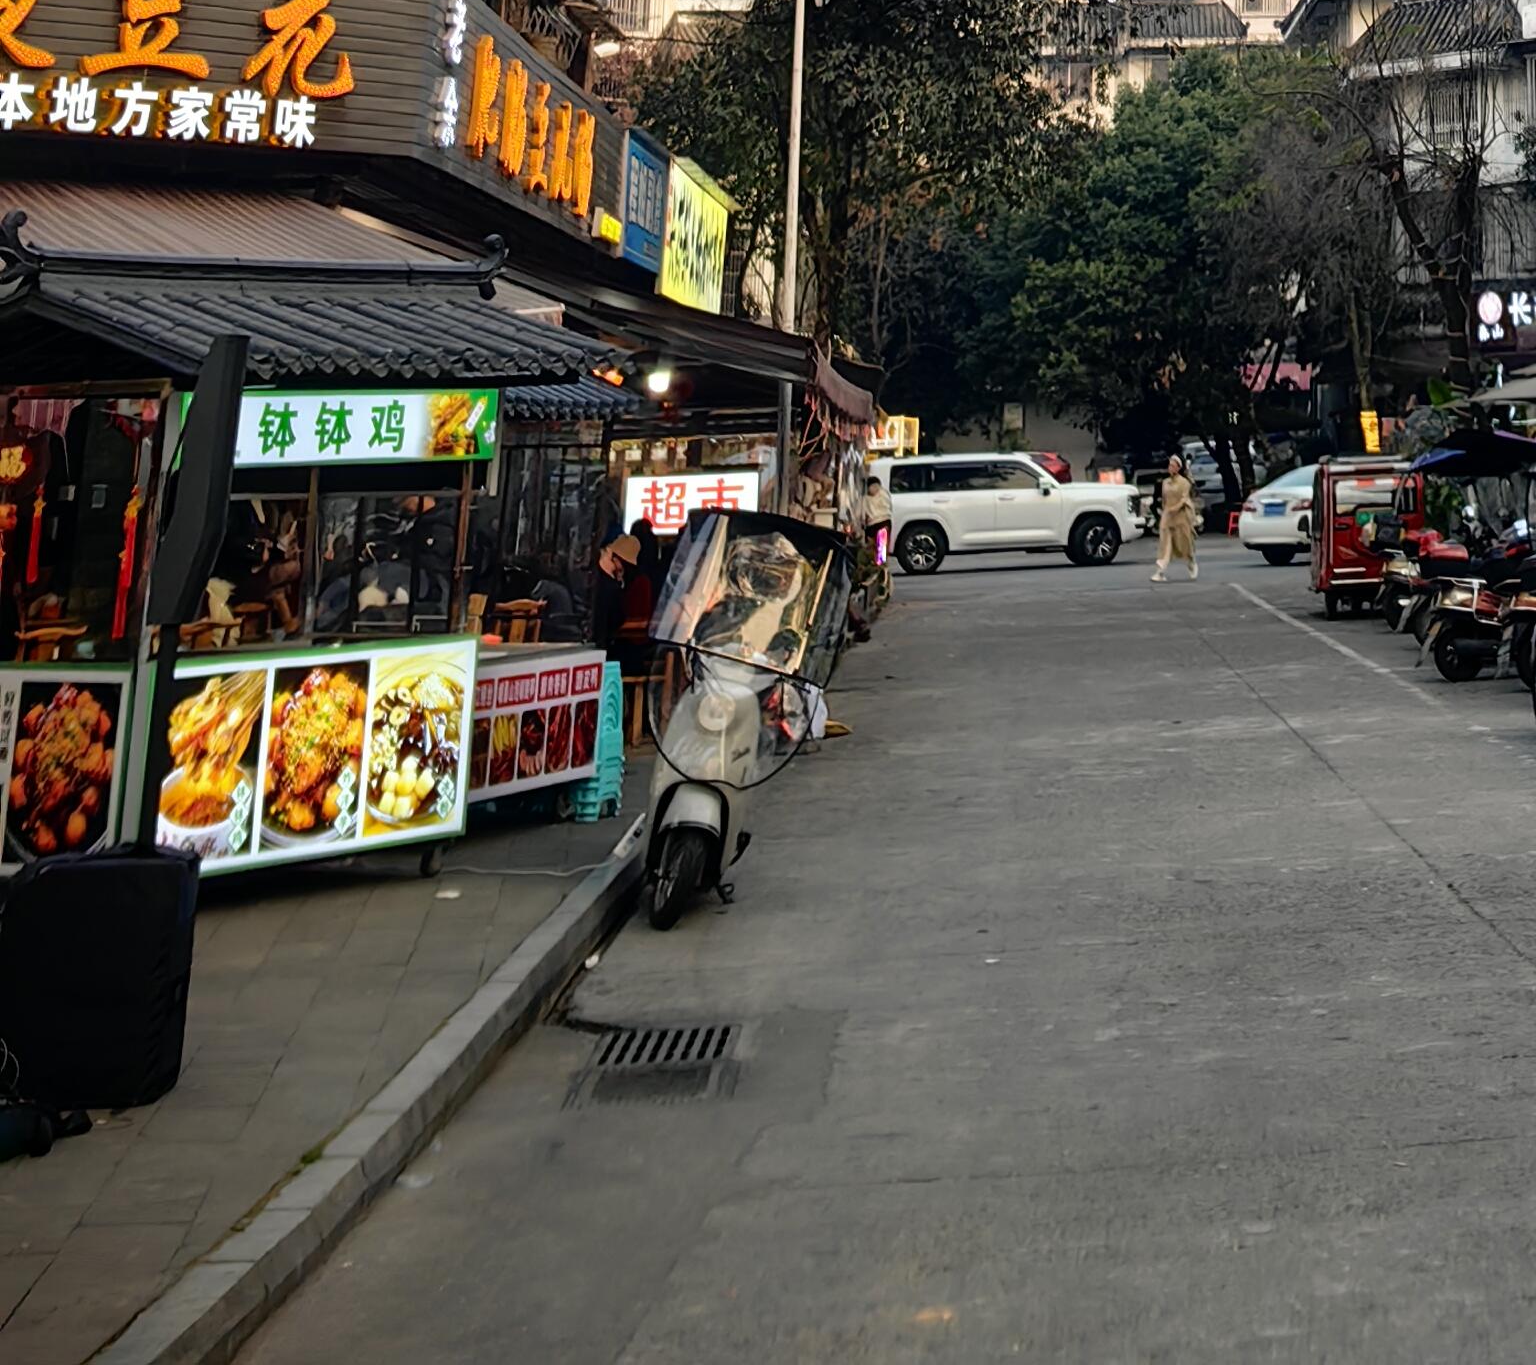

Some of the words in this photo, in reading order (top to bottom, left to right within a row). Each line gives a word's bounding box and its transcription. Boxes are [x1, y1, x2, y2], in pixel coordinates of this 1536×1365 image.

[0, 71, 317, 149] 本地方家常味
[257, 398, 406, 458] 钵钵鸡
[640, 477, 745, 529] 超市
